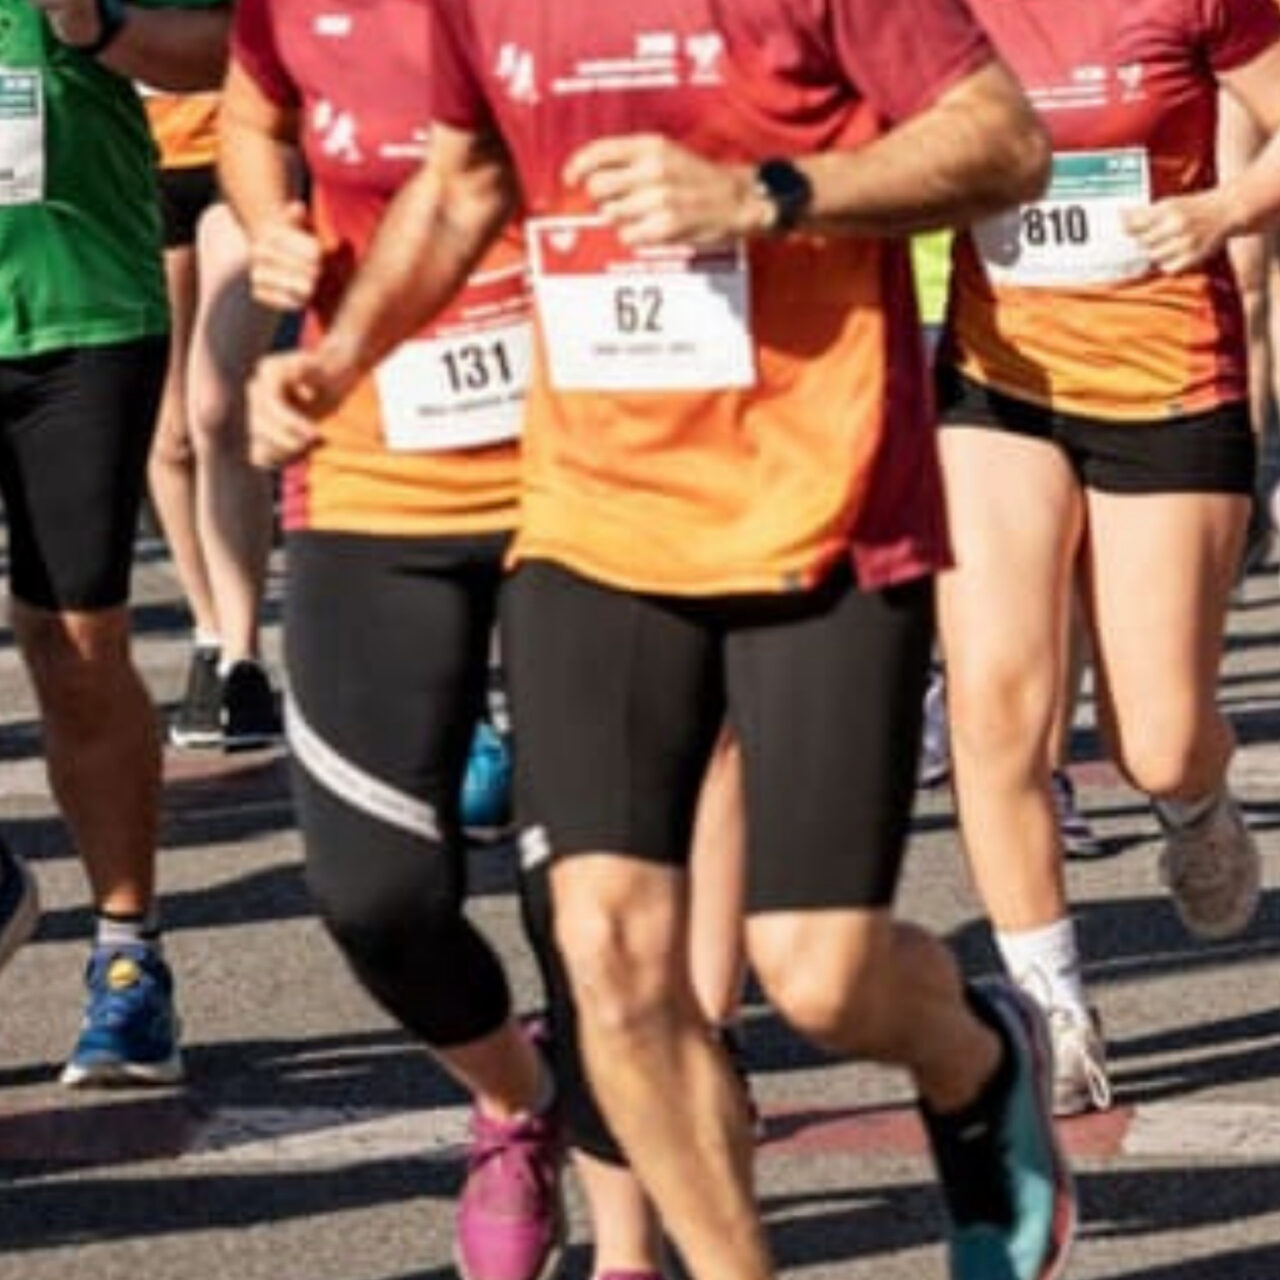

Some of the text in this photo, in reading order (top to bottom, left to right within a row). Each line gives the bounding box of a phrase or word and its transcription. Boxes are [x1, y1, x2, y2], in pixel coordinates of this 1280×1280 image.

[1023, 203, 1089, 246] 810
[614, 285, 664, 334] 62
[440, 340, 516, 394] 131
